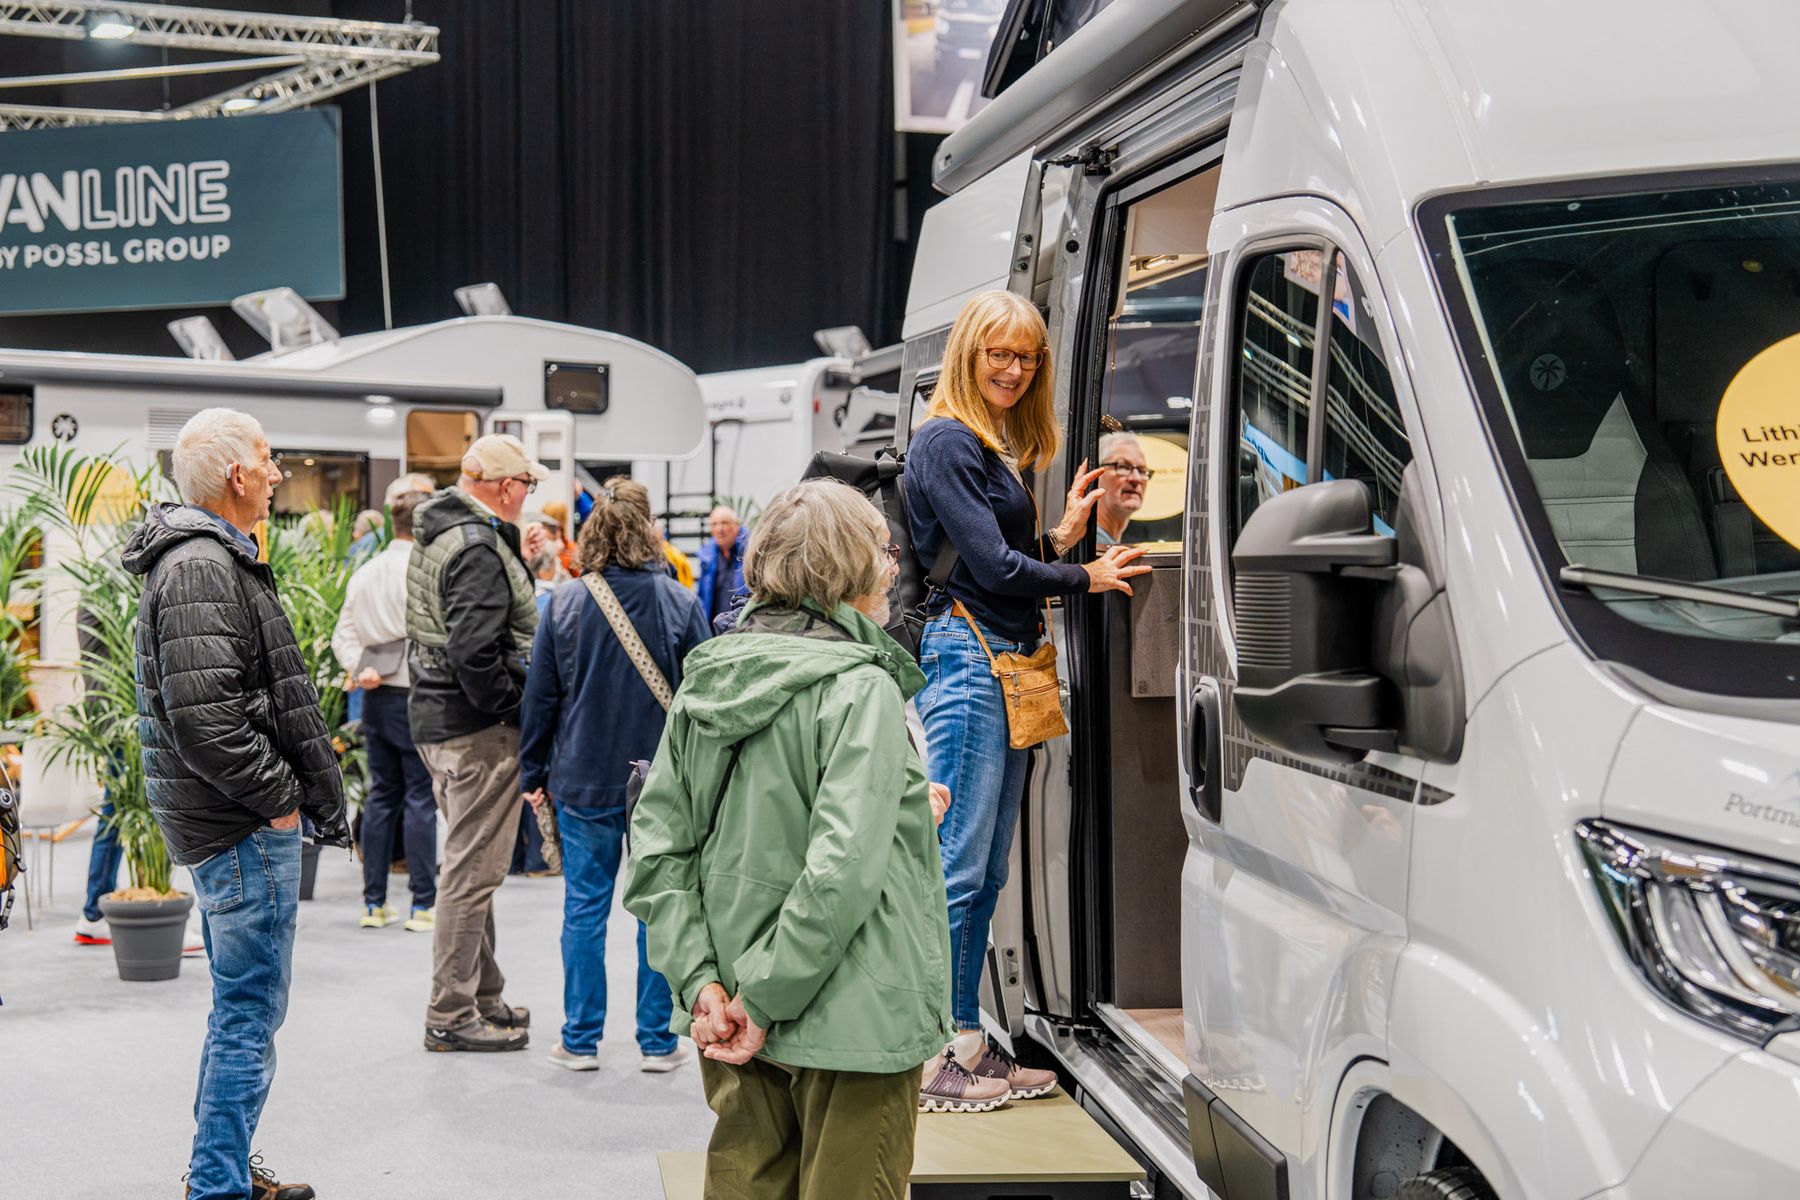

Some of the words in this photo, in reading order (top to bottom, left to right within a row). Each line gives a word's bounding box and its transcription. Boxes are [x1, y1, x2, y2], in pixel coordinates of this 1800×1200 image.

[0, 245, 20, 270] Y
[23, 240, 119, 269] PÖSSL
[122, 234, 231, 264] GROUP
[1741, 424, 1800, 443] Lith
